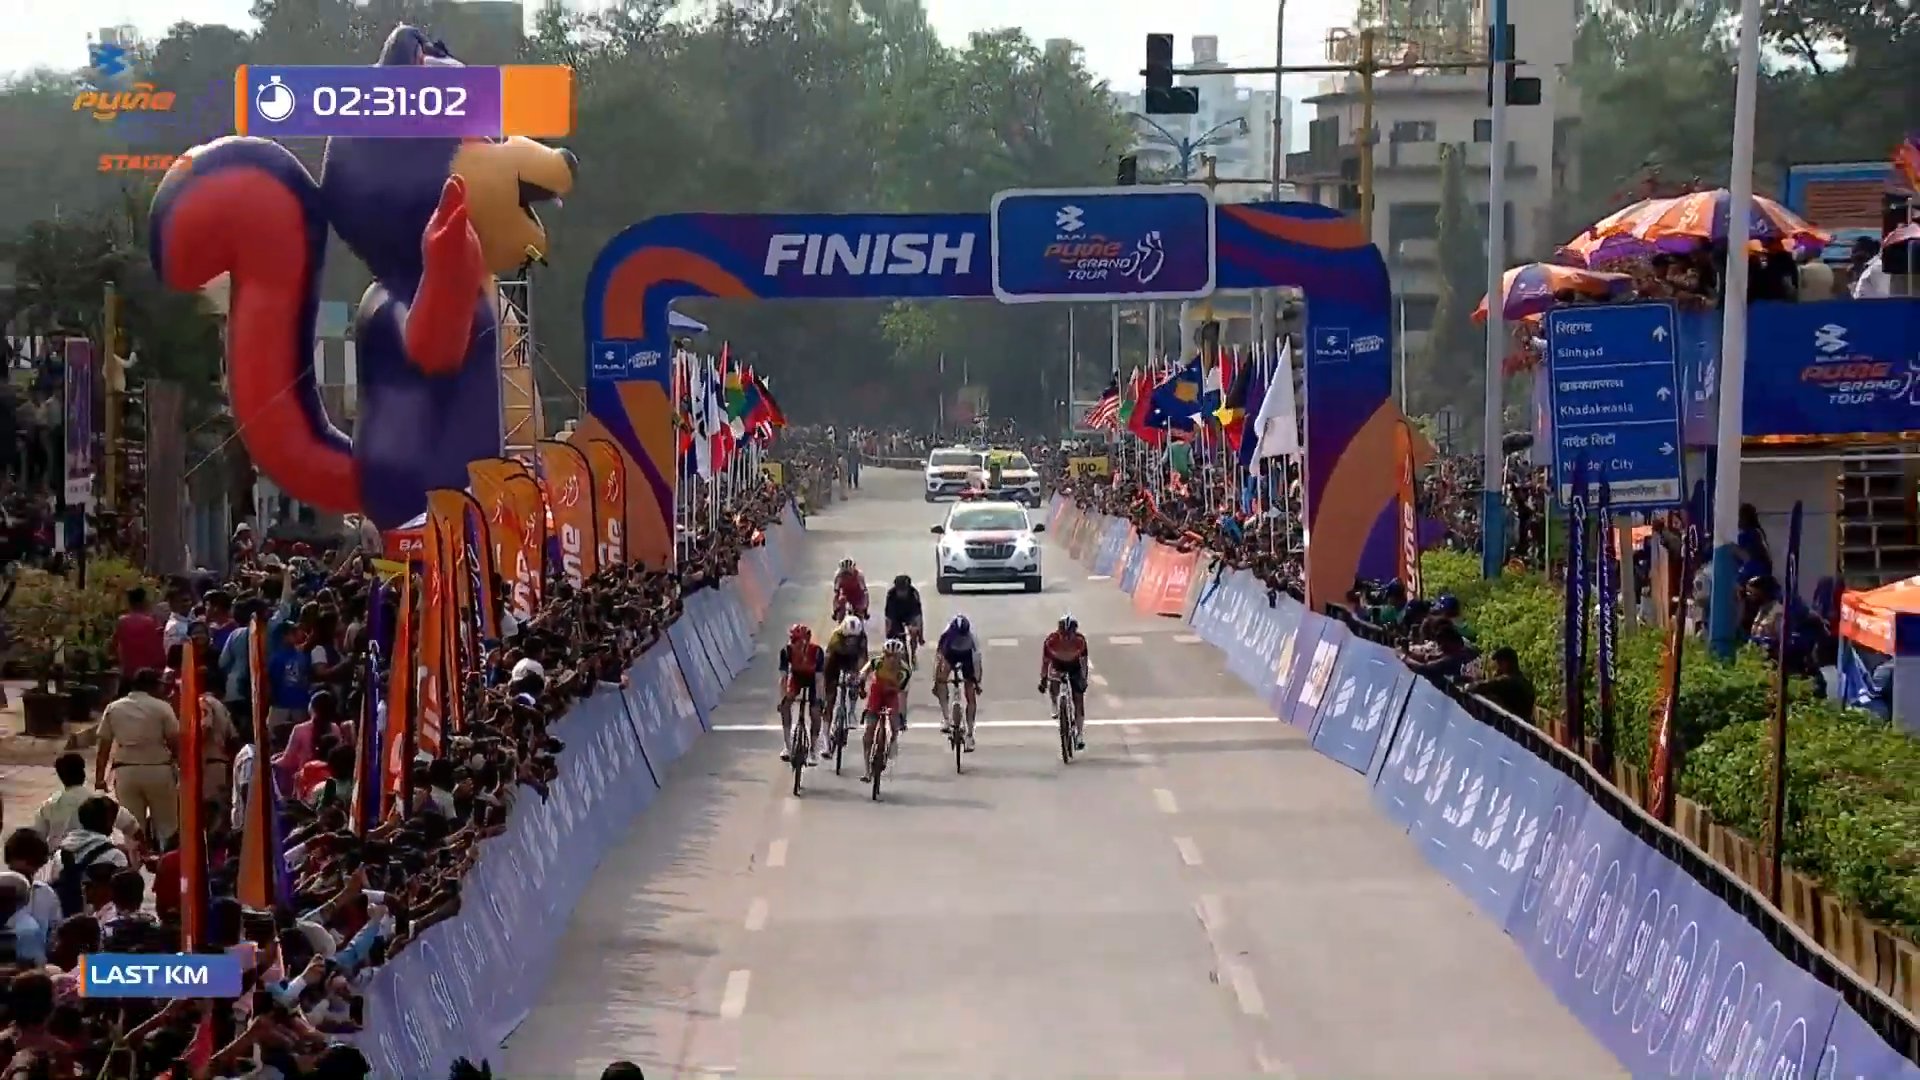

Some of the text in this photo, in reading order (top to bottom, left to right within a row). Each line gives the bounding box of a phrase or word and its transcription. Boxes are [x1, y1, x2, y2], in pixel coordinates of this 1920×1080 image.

[764, 233, 975, 276] FINISH
[1077, 257, 1131, 269] GRAND
[1067, 269, 1108, 280] TOUR
[1557, 346, 1604, 359] Sinhgad
[1839, 379, 1901, 393] GRAND
[1828, 392, 1875, 405] TOUR
[1611, 458, 1634, 471] City
